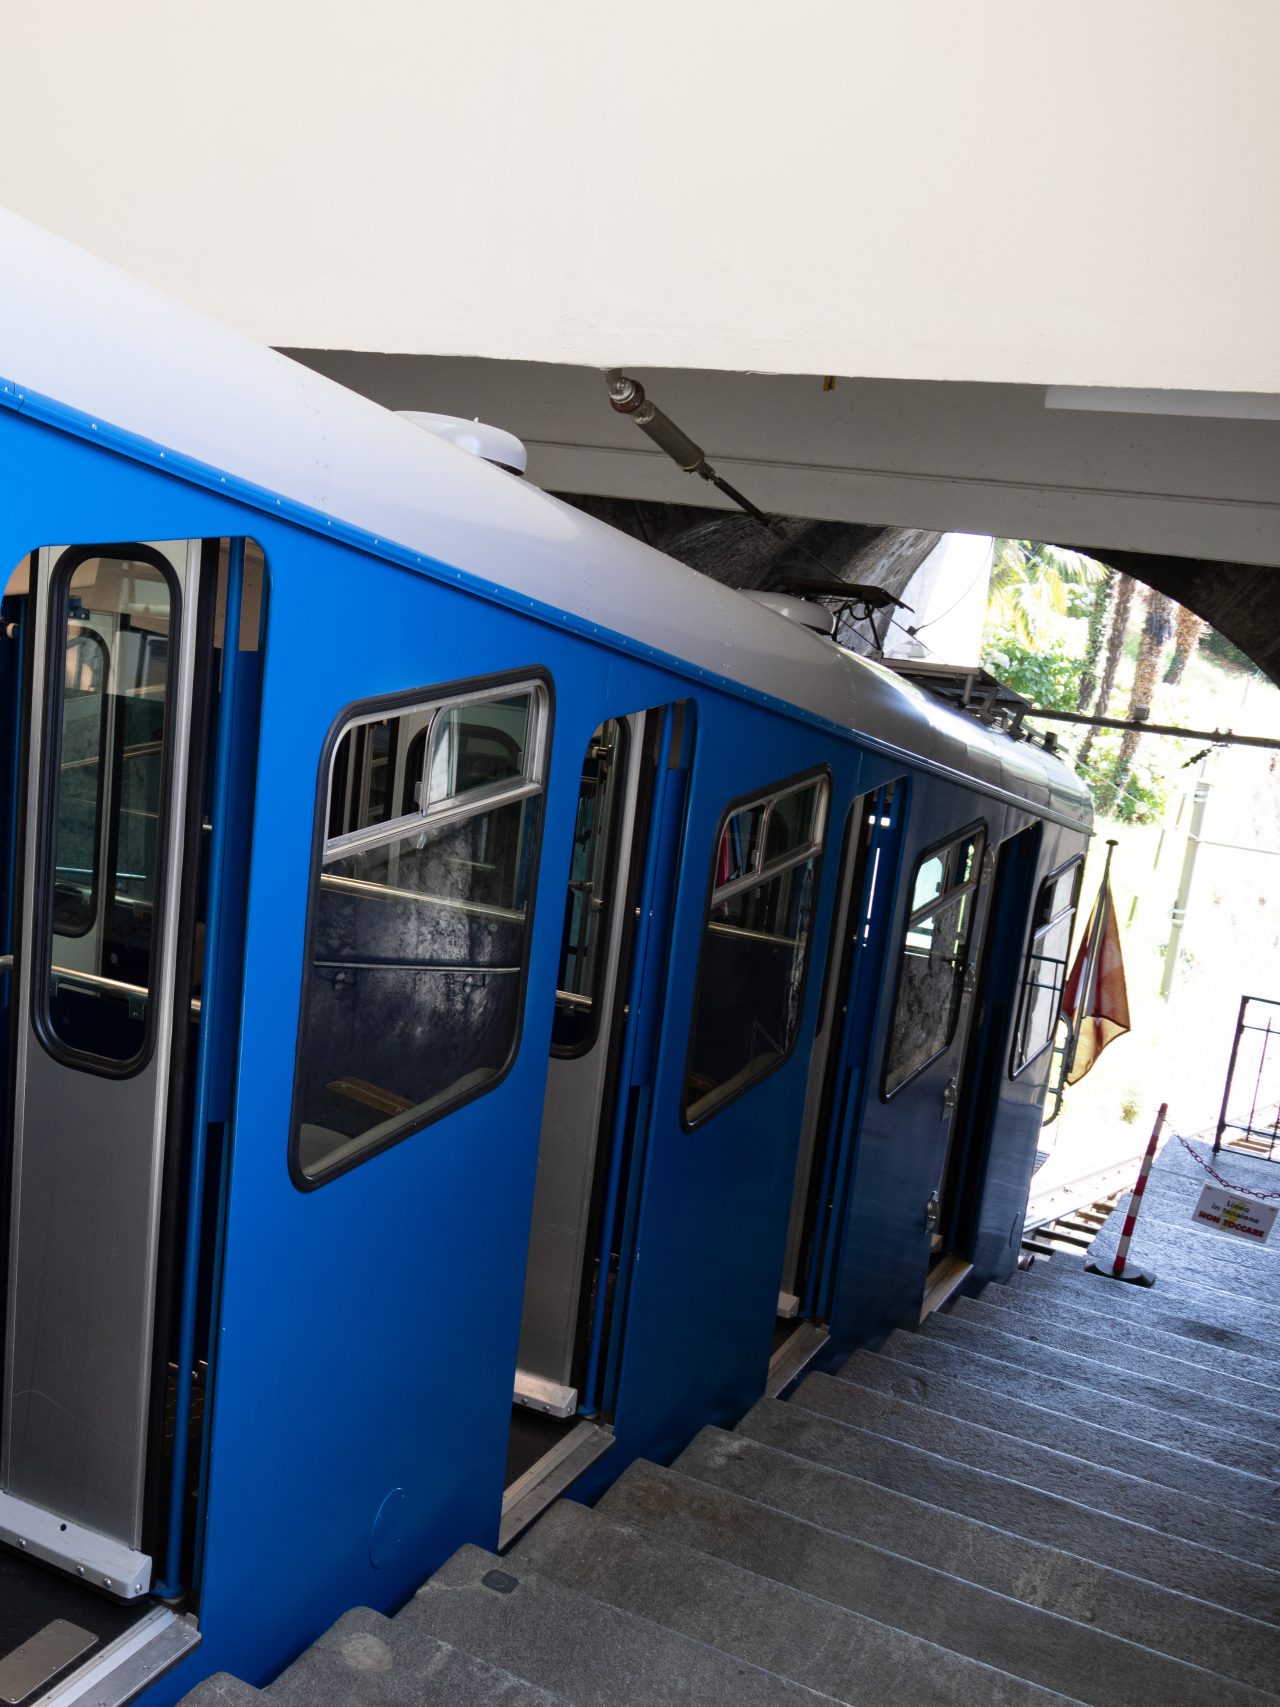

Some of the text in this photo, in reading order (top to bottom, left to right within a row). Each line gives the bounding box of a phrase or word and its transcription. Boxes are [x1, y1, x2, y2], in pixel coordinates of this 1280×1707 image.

[1211, 1203, 1260, 1224] in tensione
[1226, 1200, 1250, 1213] Linea
[1198, 1210, 1265, 1238] NON TOCCARE
